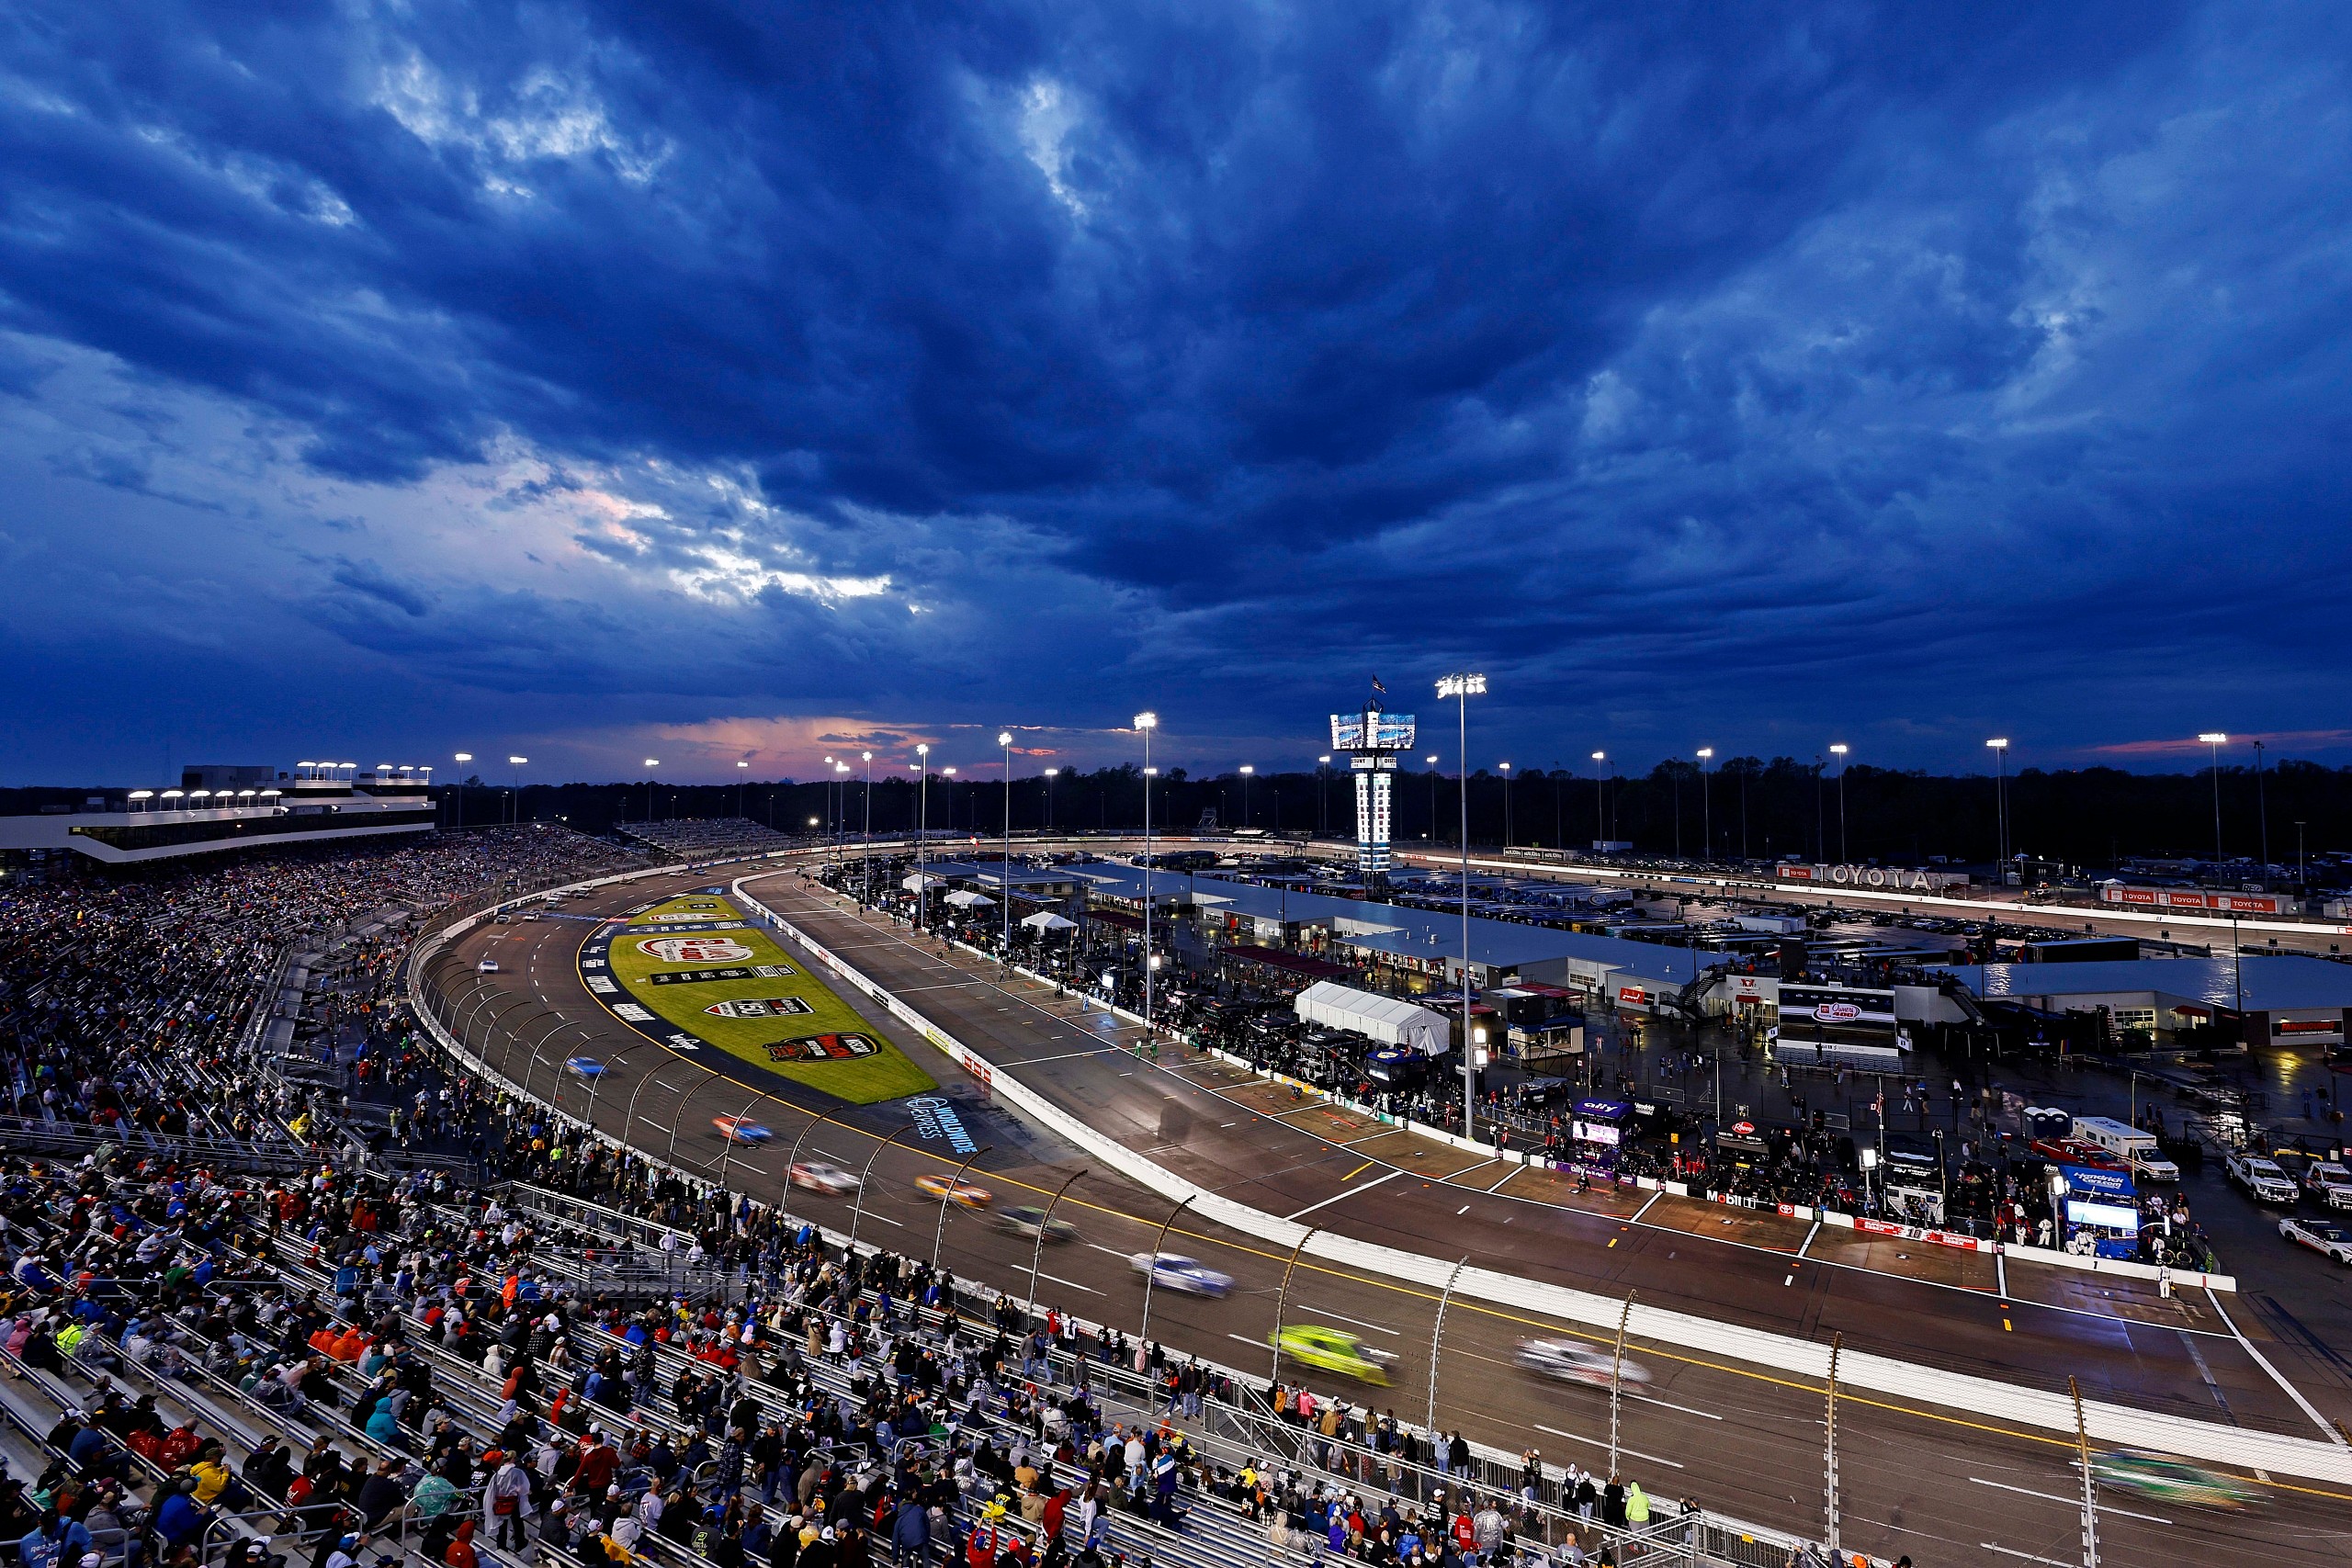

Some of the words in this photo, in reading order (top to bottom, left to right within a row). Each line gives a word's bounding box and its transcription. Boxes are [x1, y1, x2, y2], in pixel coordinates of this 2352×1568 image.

[1815, 863, 1932, 891] TOYOTA
[2124, 893, 2152, 901] TOYOTA
[2233, 900, 2265, 908] TOYOTA
[2281, 1021, 2335, 1031] FANGROUNDS
[1583, 1102, 1619, 1112] ally
[910, 1108, 943, 1139] EXPRESS
[933, 1106, 978, 1154] WORLDWIDE
[2065, 1145, 2074, 1155] F1
[1546, 1160, 1557, 1169] 48
[1570, 1165, 1586, 1177] ally
[2074, 1172, 2124, 1183] Hendrick
[2082, 1178, 2121, 1190] Cars.com
[1706, 1190, 1742, 1207] Mobil
[1864, 1221, 1894, 1230] SUPERIOR
[1907, 1228, 1922, 1239] 10
[1942, 1235, 1974, 1245] SUPERIOR
